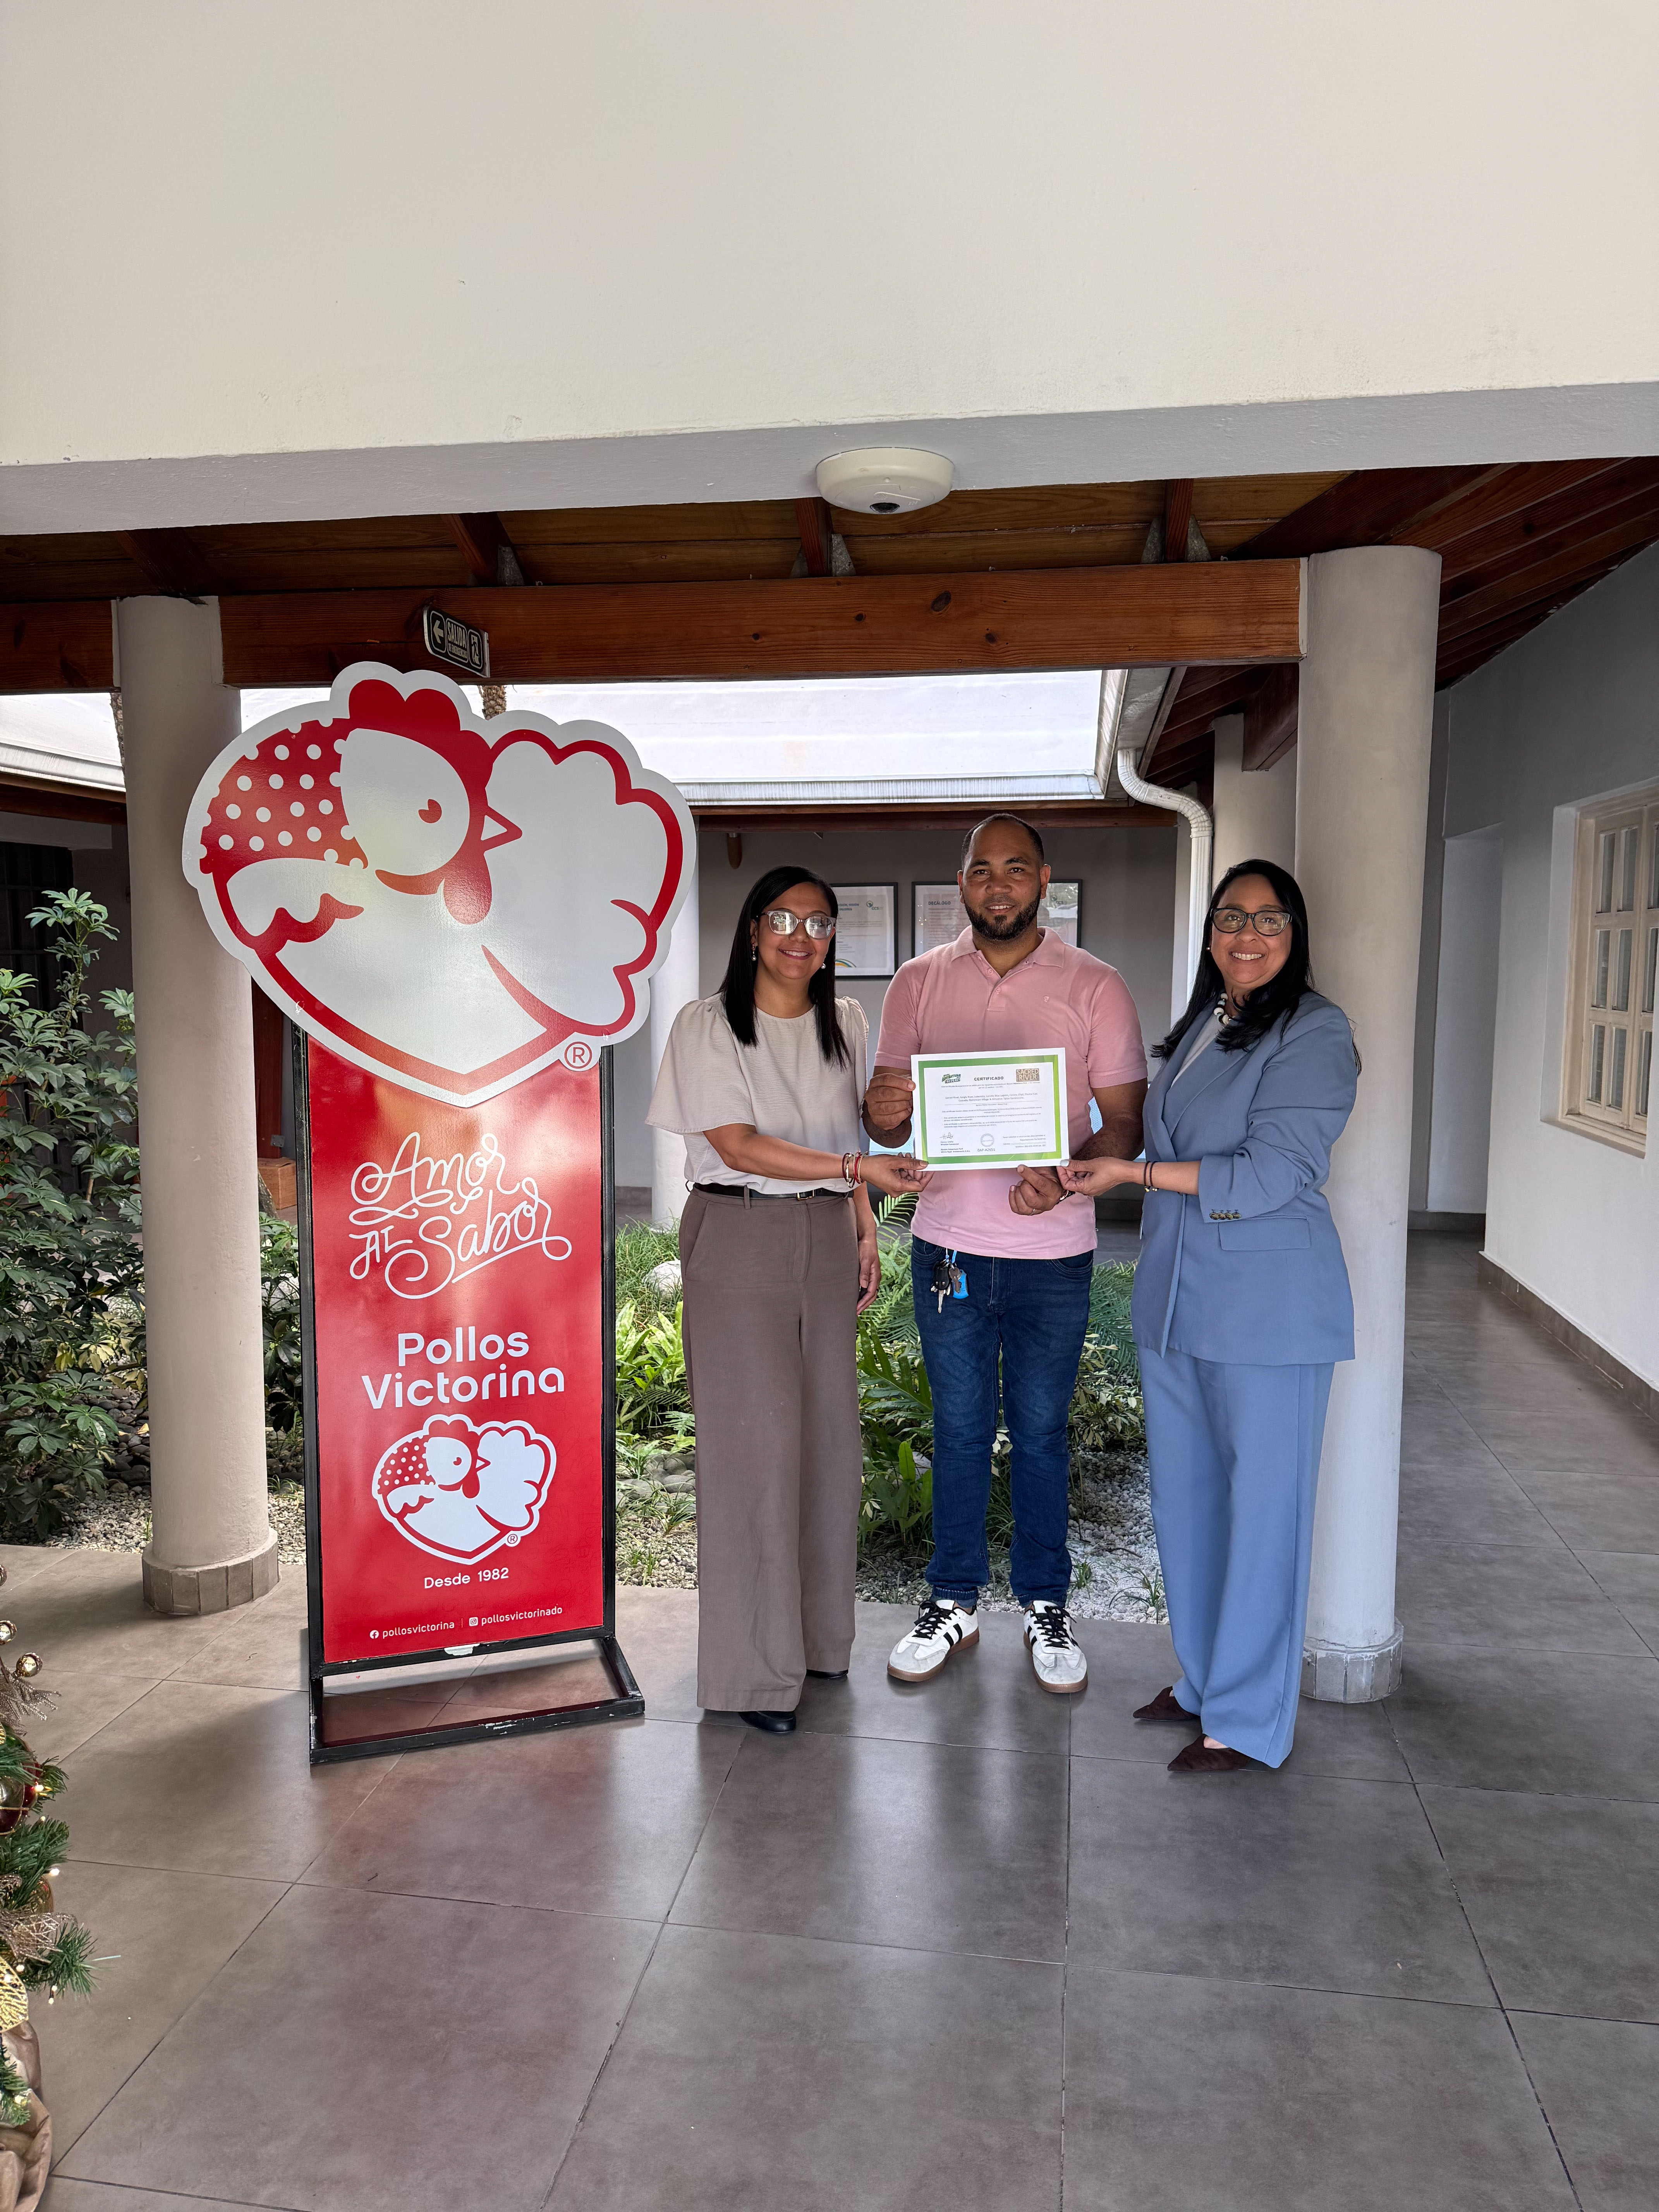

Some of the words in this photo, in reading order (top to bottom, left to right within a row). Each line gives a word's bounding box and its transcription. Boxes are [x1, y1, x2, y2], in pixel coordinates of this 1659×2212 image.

[448, 622, 467, 649] SALIDA
[349, 1132, 520, 1225] Amor
[385, 1177, 572, 1299] Sabor
[398, 1326, 529, 1366] Pollos
[362, 1364, 564, 1409] Victorina
[424, 1572, 471, 1589] Desde
[477, 1568, 509, 1582] 1982
[382, 1621, 455, 1638] pollosvictorina
[481, 1606, 562, 1625] pollosvictorinado
